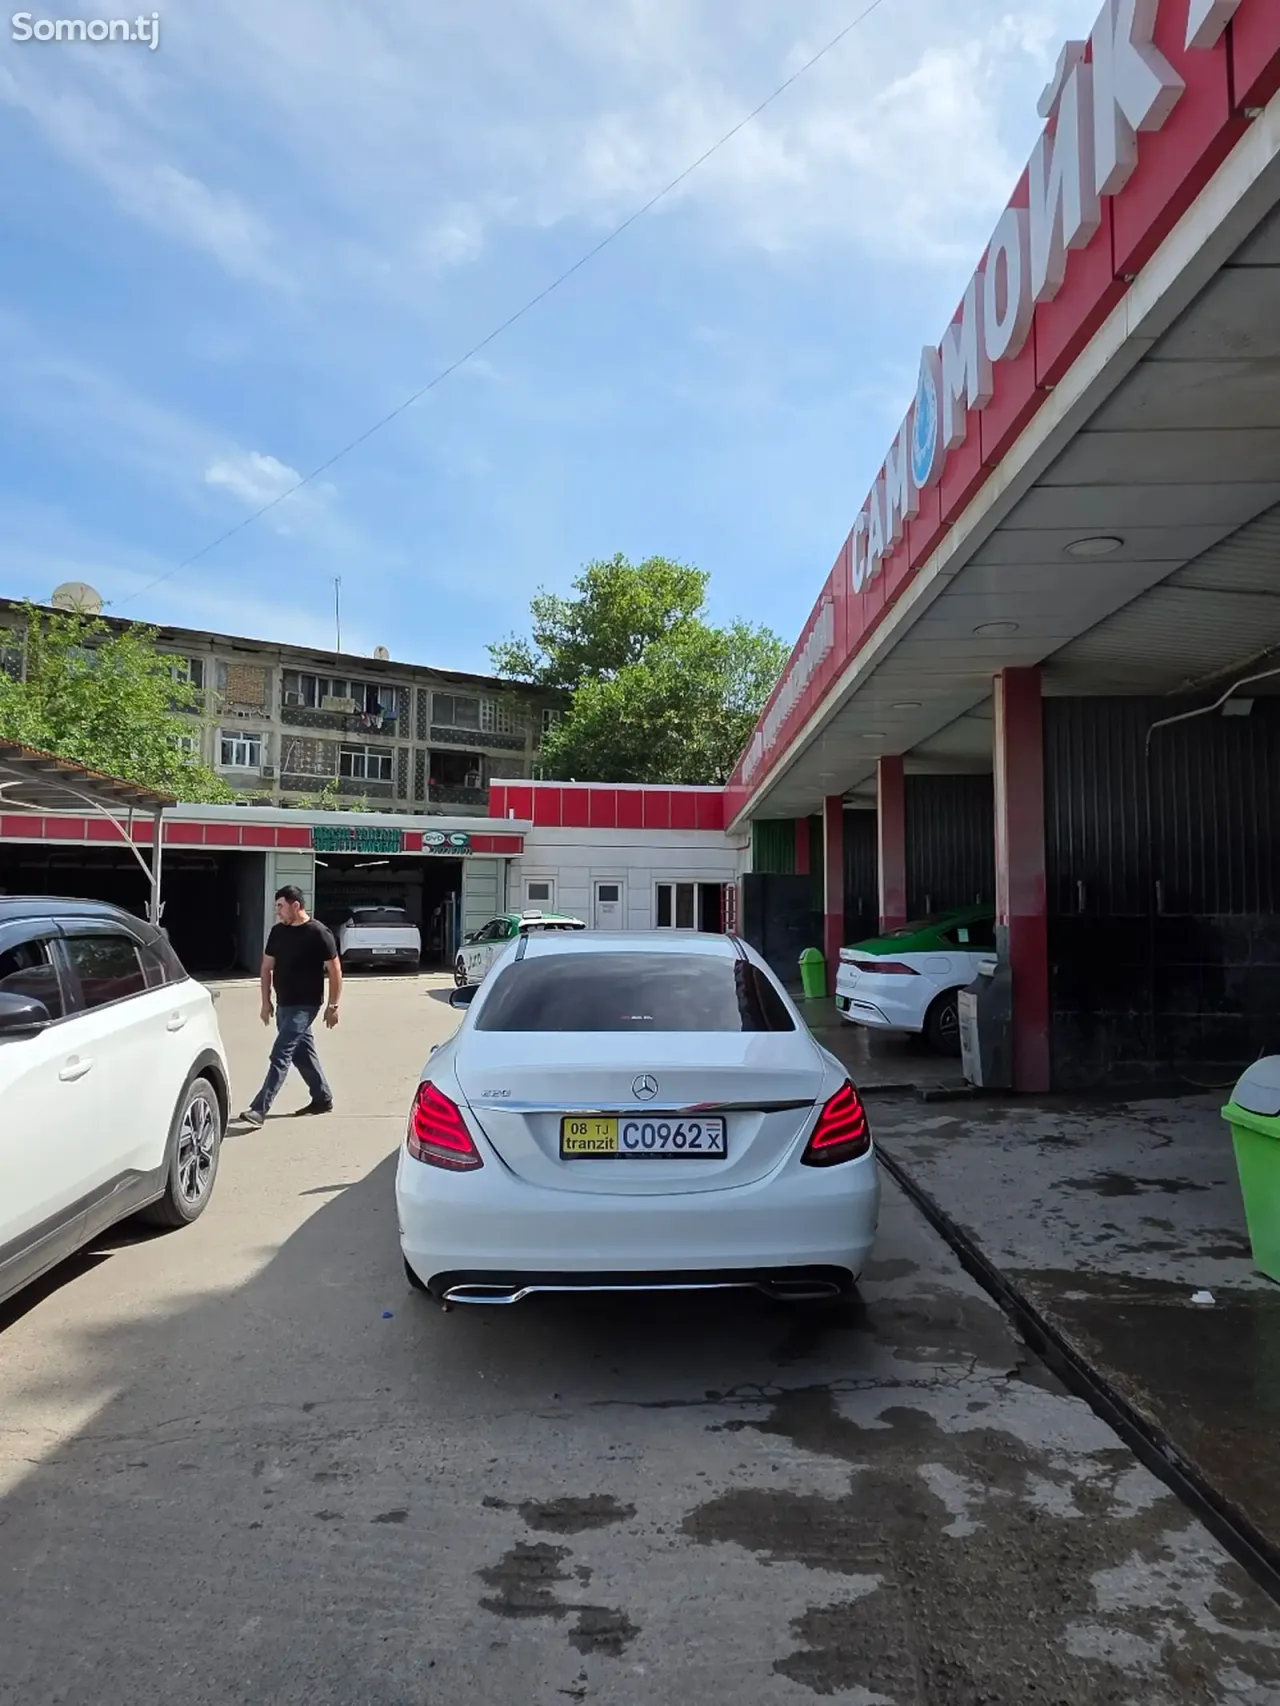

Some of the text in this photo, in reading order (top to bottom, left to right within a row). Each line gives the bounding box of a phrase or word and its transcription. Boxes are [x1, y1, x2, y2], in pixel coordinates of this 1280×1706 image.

[571, 1123, 609, 1135] 08 TJ
[566, 1136, 614, 1150] tranzit
